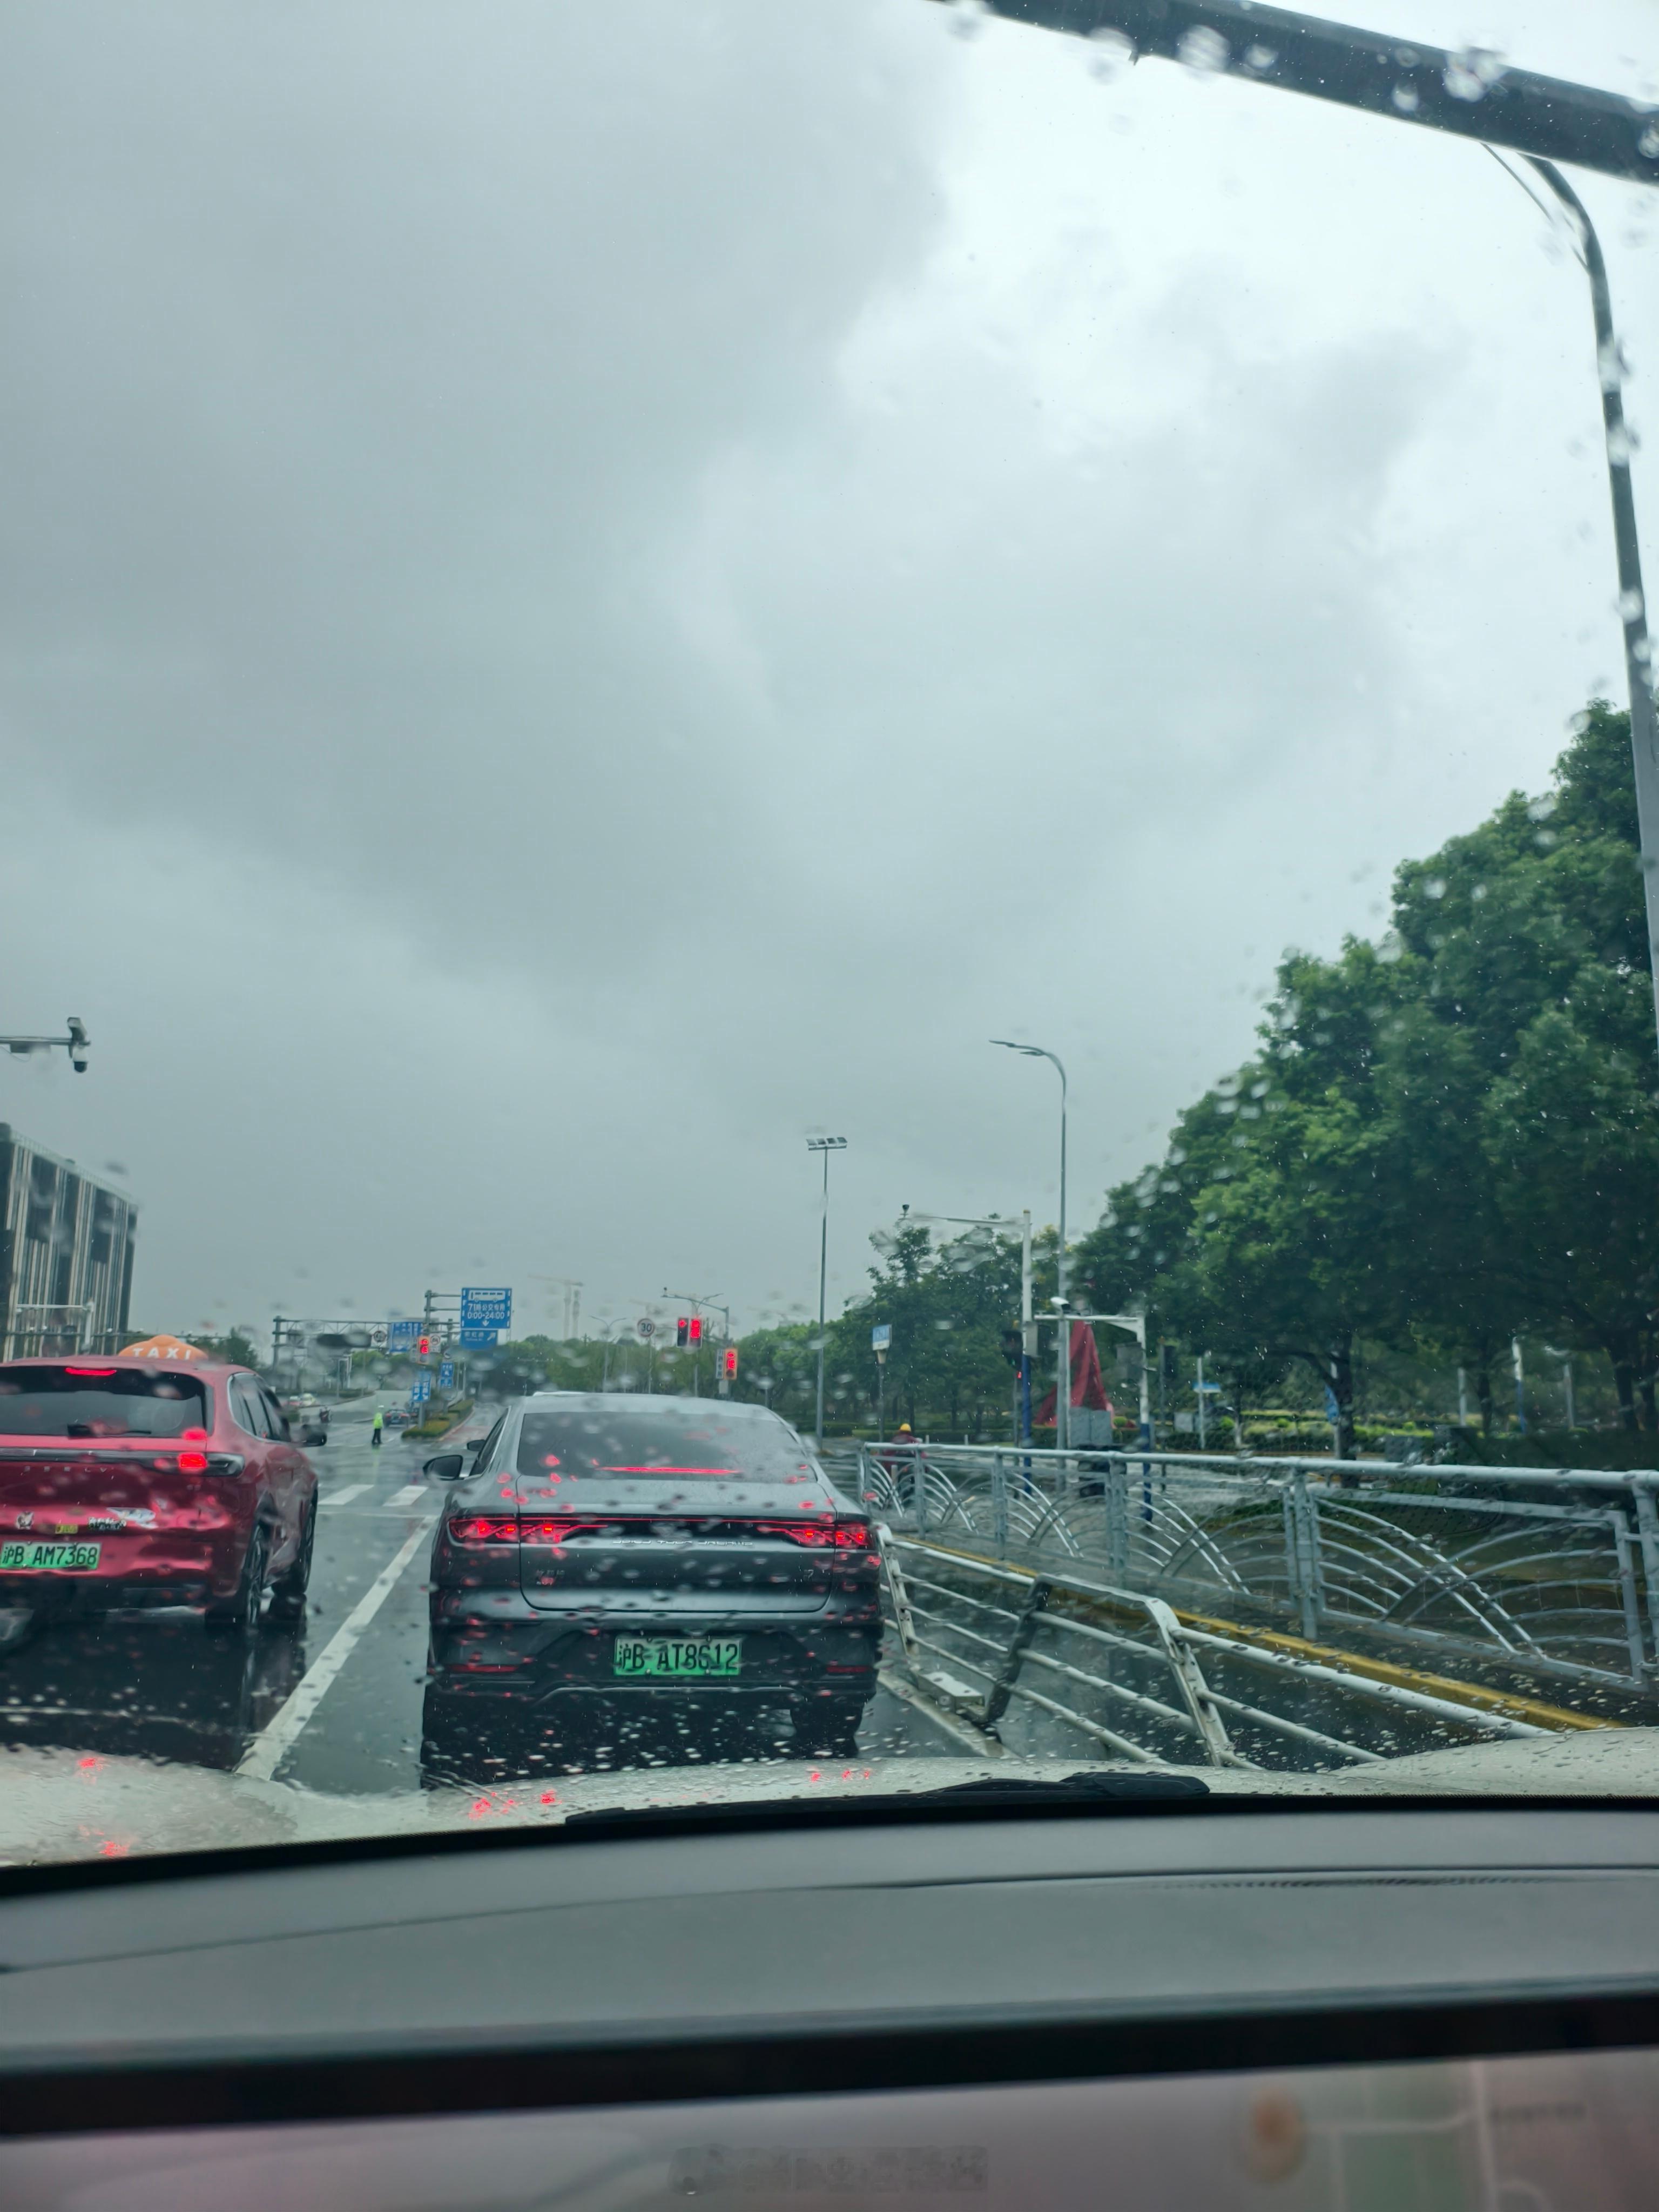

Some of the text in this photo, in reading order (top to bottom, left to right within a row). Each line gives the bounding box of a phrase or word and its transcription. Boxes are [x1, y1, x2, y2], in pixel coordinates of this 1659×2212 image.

[467, 1311, 505, 1319] 0:00-24:00
[641, 1323, 652, 1332] 30
[132, 1347, 192, 1360] TAXI
